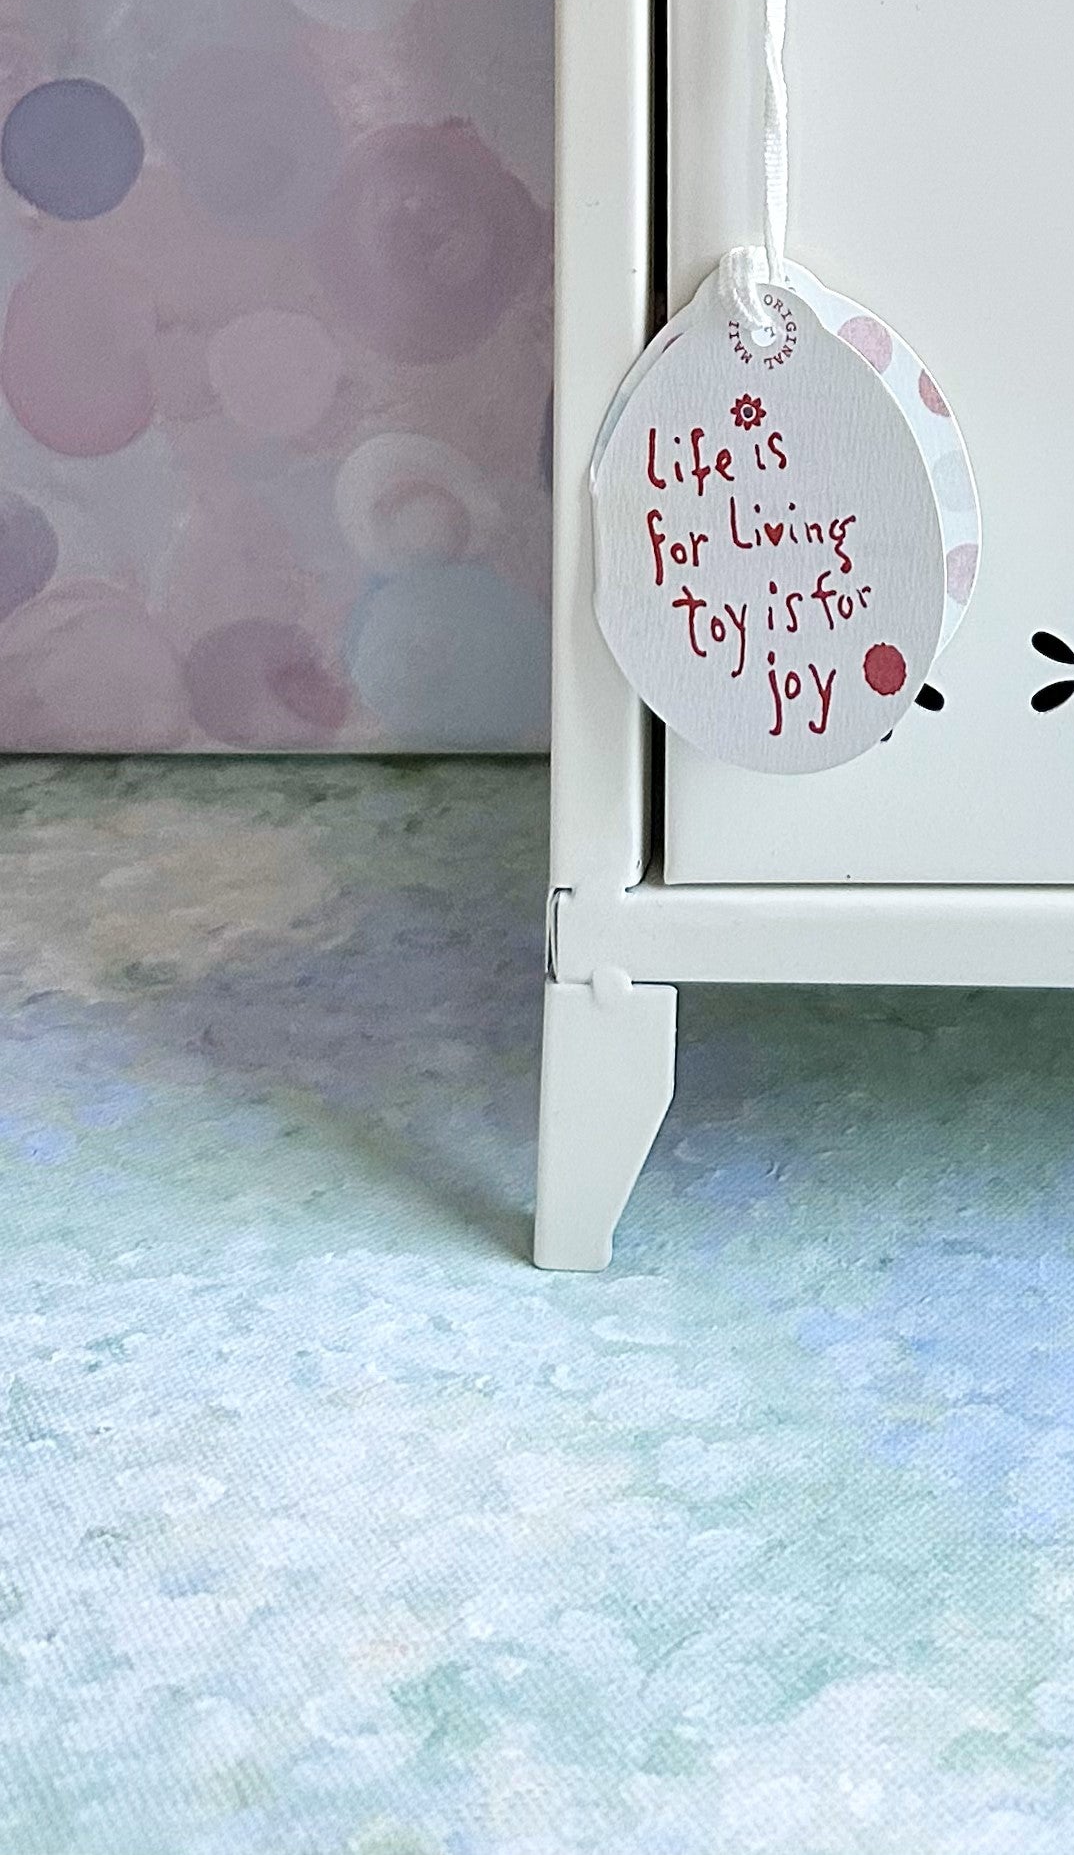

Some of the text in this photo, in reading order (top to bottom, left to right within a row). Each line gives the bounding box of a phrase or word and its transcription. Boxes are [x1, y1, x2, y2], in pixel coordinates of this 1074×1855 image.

[763, 293, 797, 370] ORIGINAL
[754, 432, 788, 471] is
[646, 509, 709, 586] for
[672, 570, 873, 678] toy is for
[767, 651, 837, 736] joy
